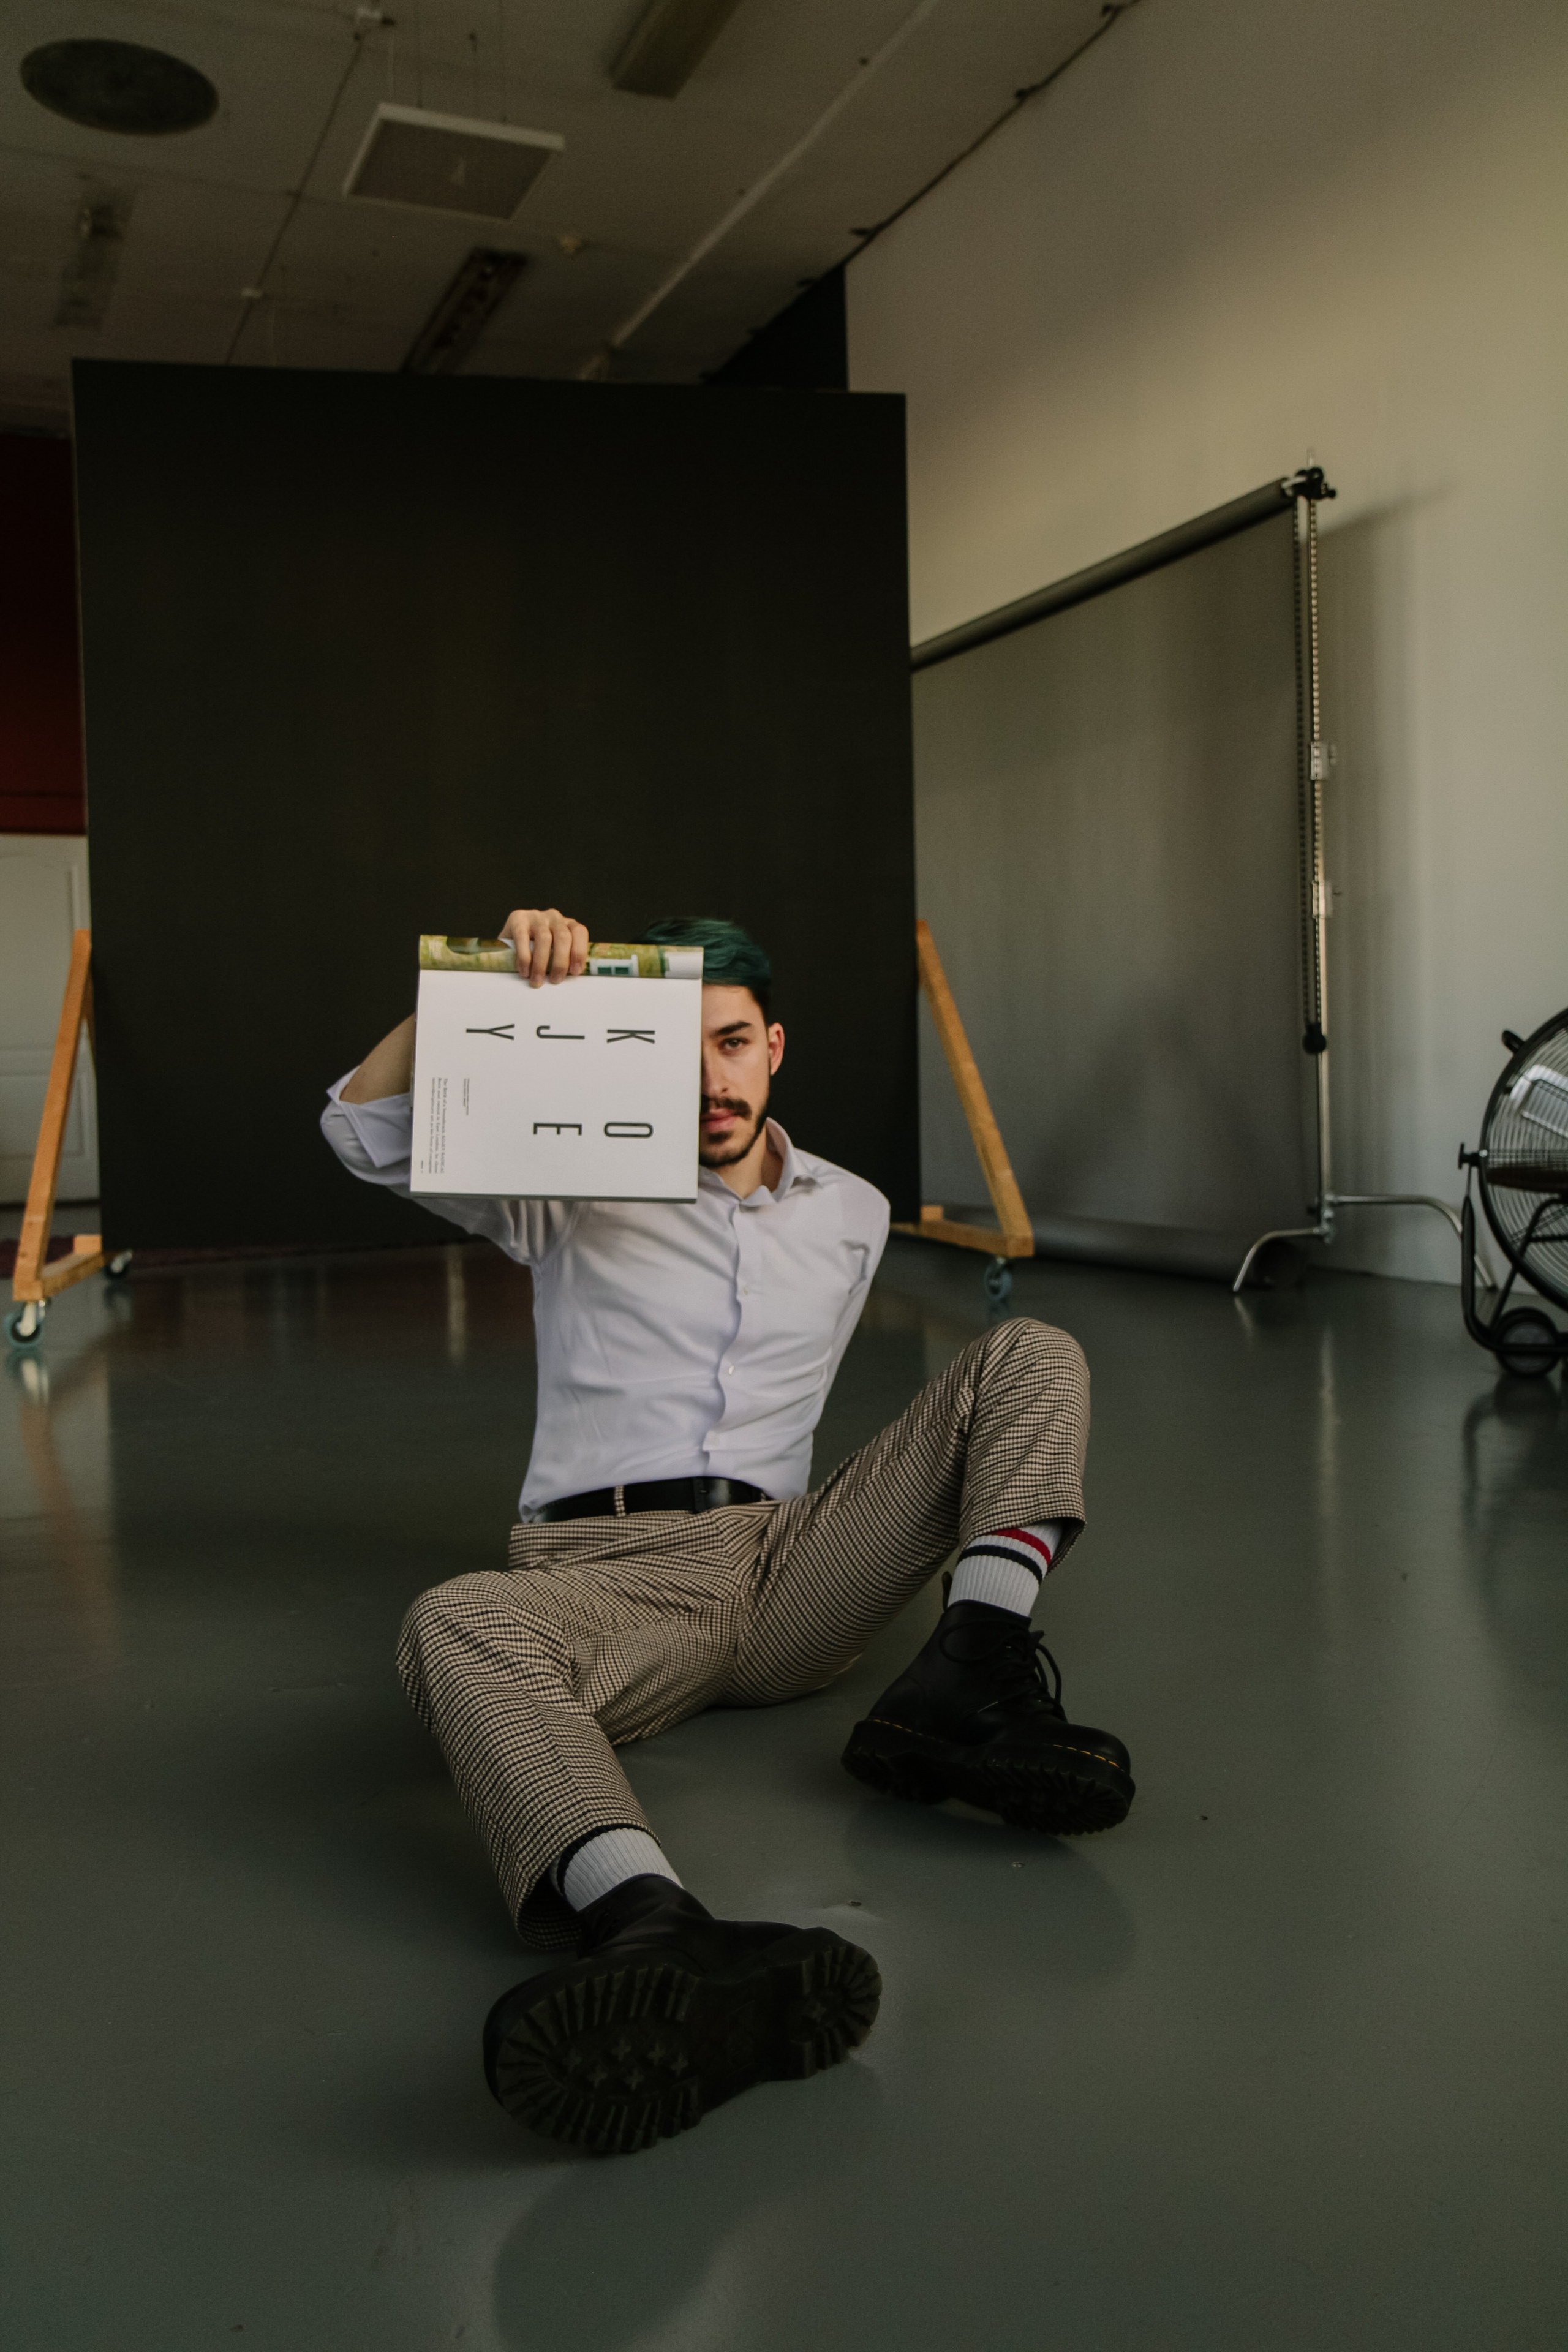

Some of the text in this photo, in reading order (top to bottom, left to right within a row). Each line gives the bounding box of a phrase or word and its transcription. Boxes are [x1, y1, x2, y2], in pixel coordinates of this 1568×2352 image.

[466, 1024, 515, 1041] Y
[533, 1025, 585, 1136] J E
[603, 1029, 655, 1139] K O
